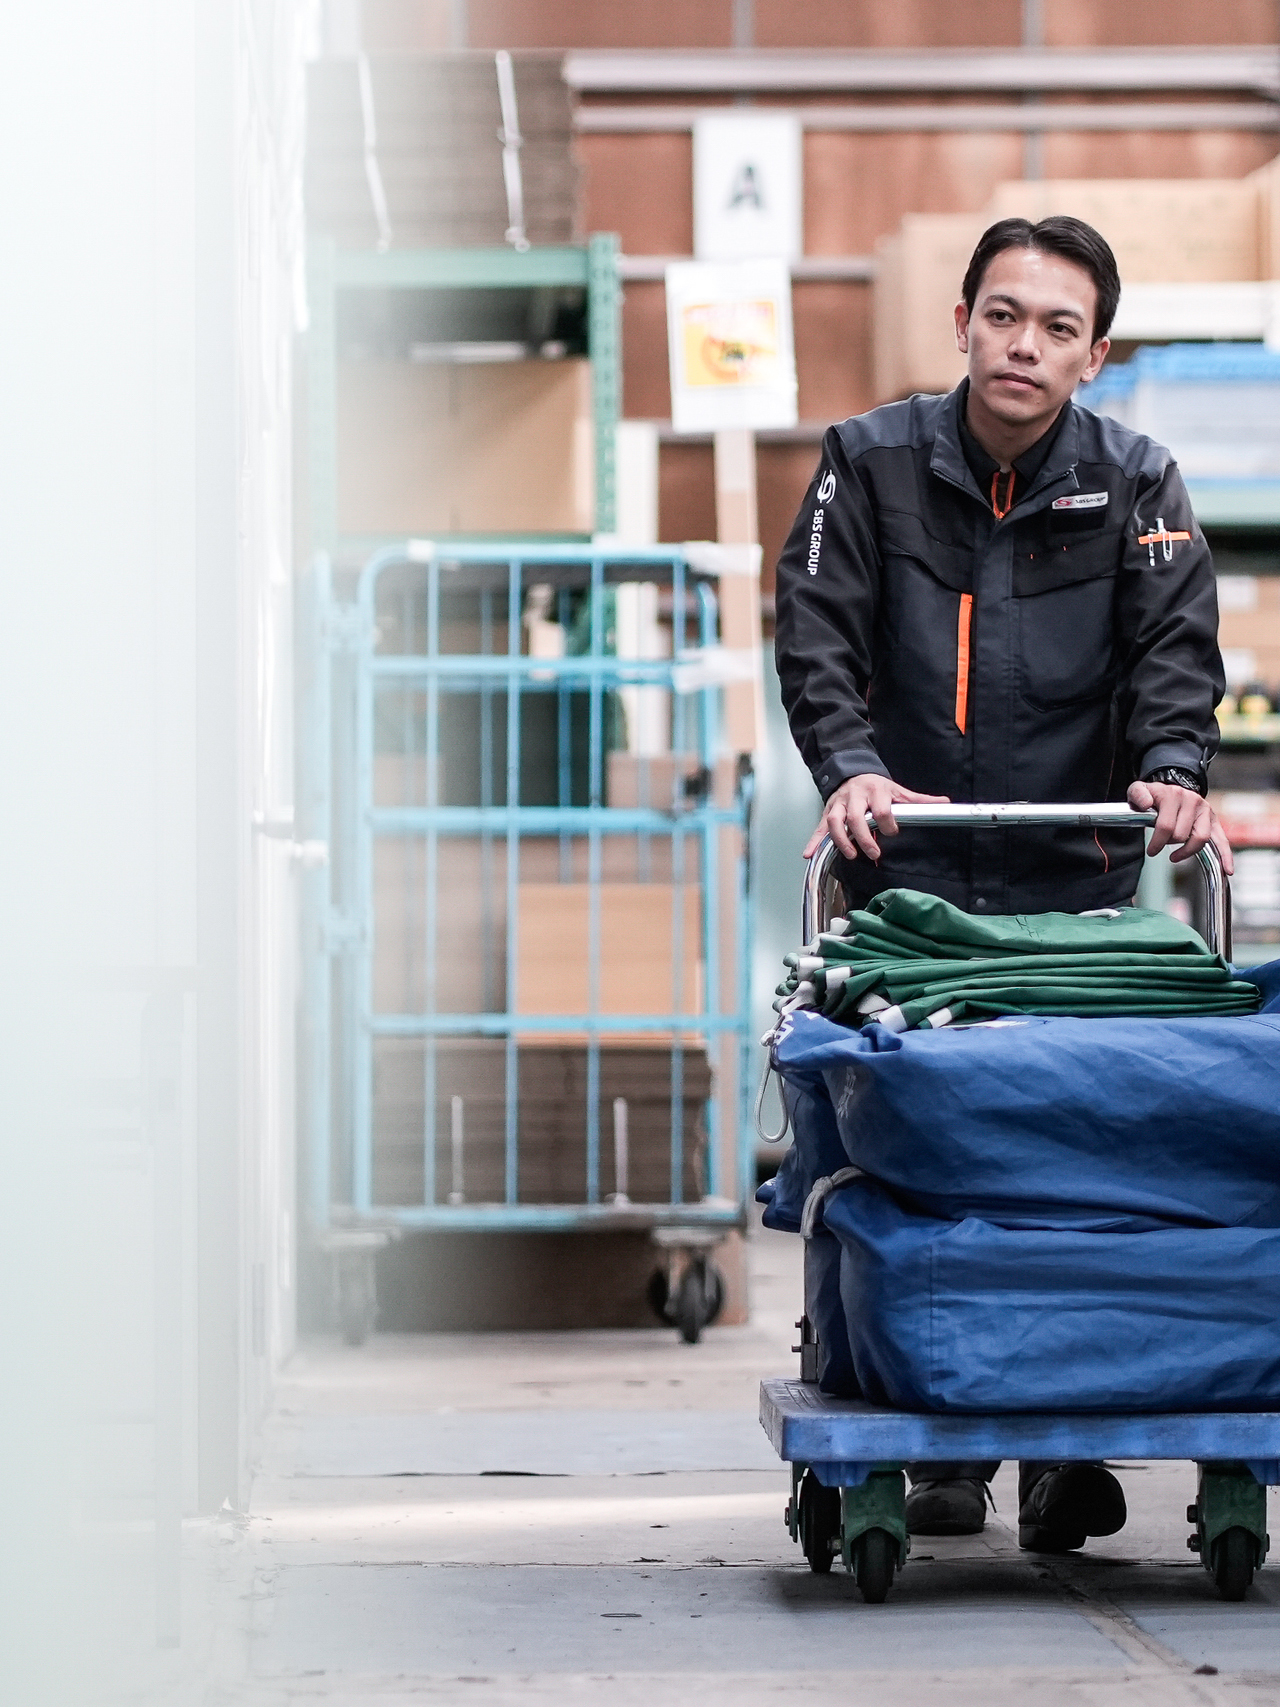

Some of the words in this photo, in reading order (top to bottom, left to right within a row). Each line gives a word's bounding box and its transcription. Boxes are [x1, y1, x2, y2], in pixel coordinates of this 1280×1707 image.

[726, 160, 769, 212] A
[811, 508, 824, 531] SBS
[806, 532, 822, 576] GROUP
